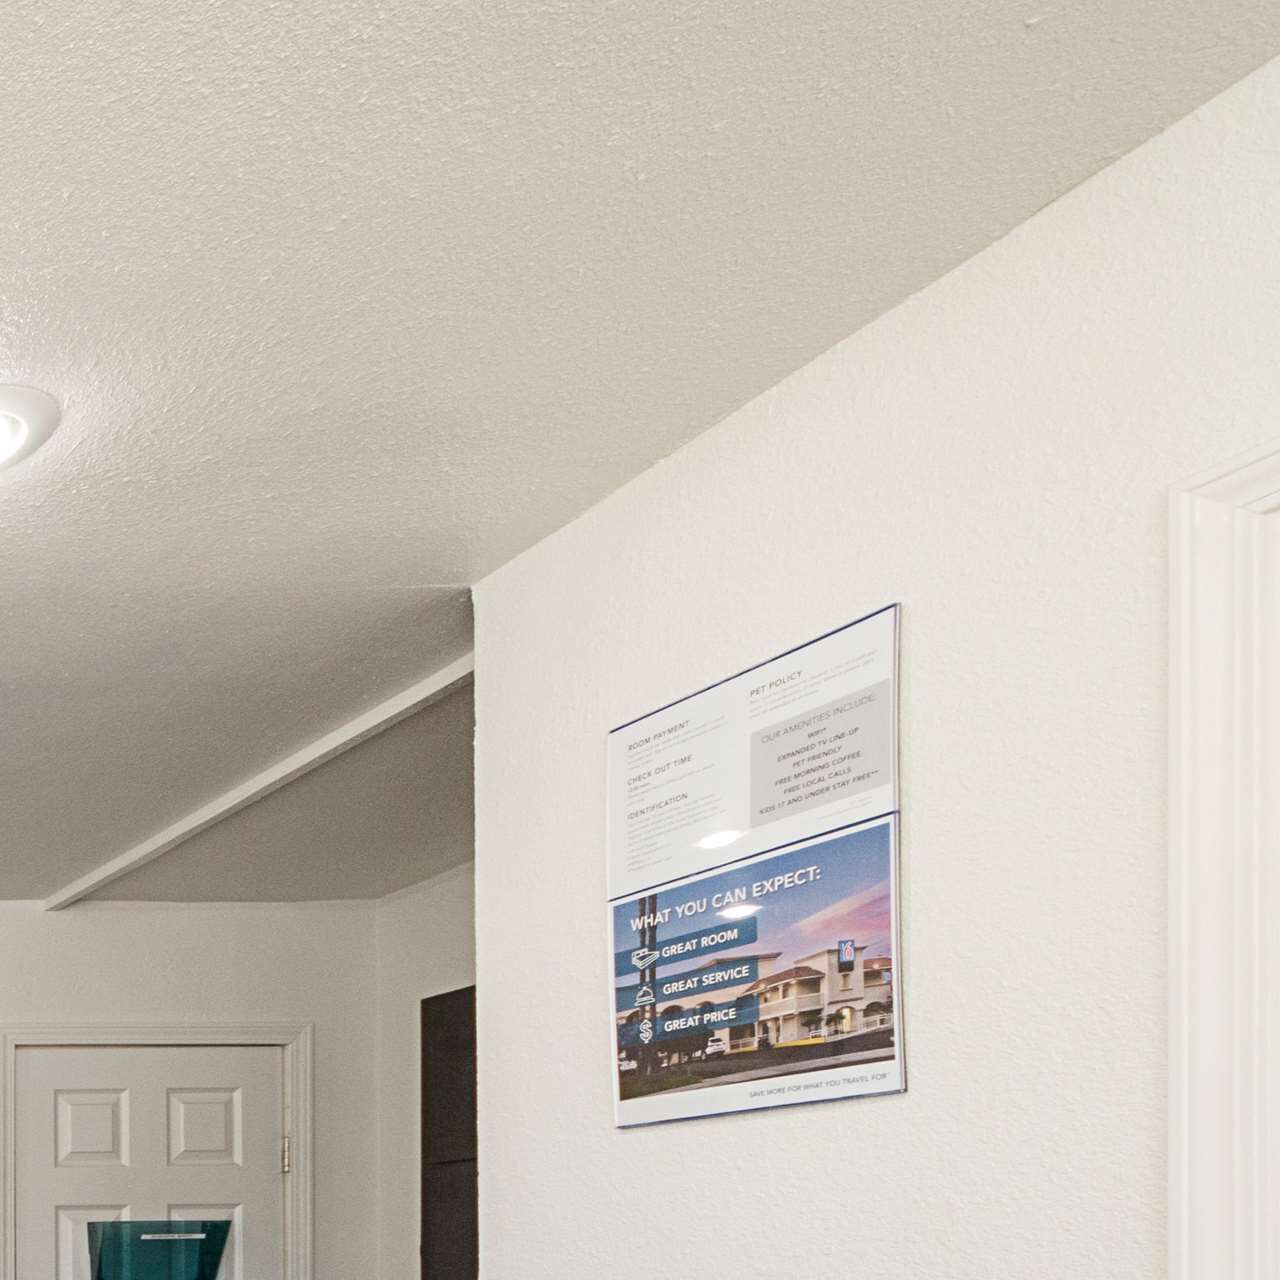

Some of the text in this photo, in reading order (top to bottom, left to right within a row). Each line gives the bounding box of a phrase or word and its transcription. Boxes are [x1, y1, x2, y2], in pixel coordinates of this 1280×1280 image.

[630, 866, 821, 931] WHAT YOU CAN EXPECT:
[662, 928, 738, 958] GREAT ROOM
[663, 965, 750, 995] GREAT SERVICE
[664, 1008, 736, 1032] GREAT PRICE
